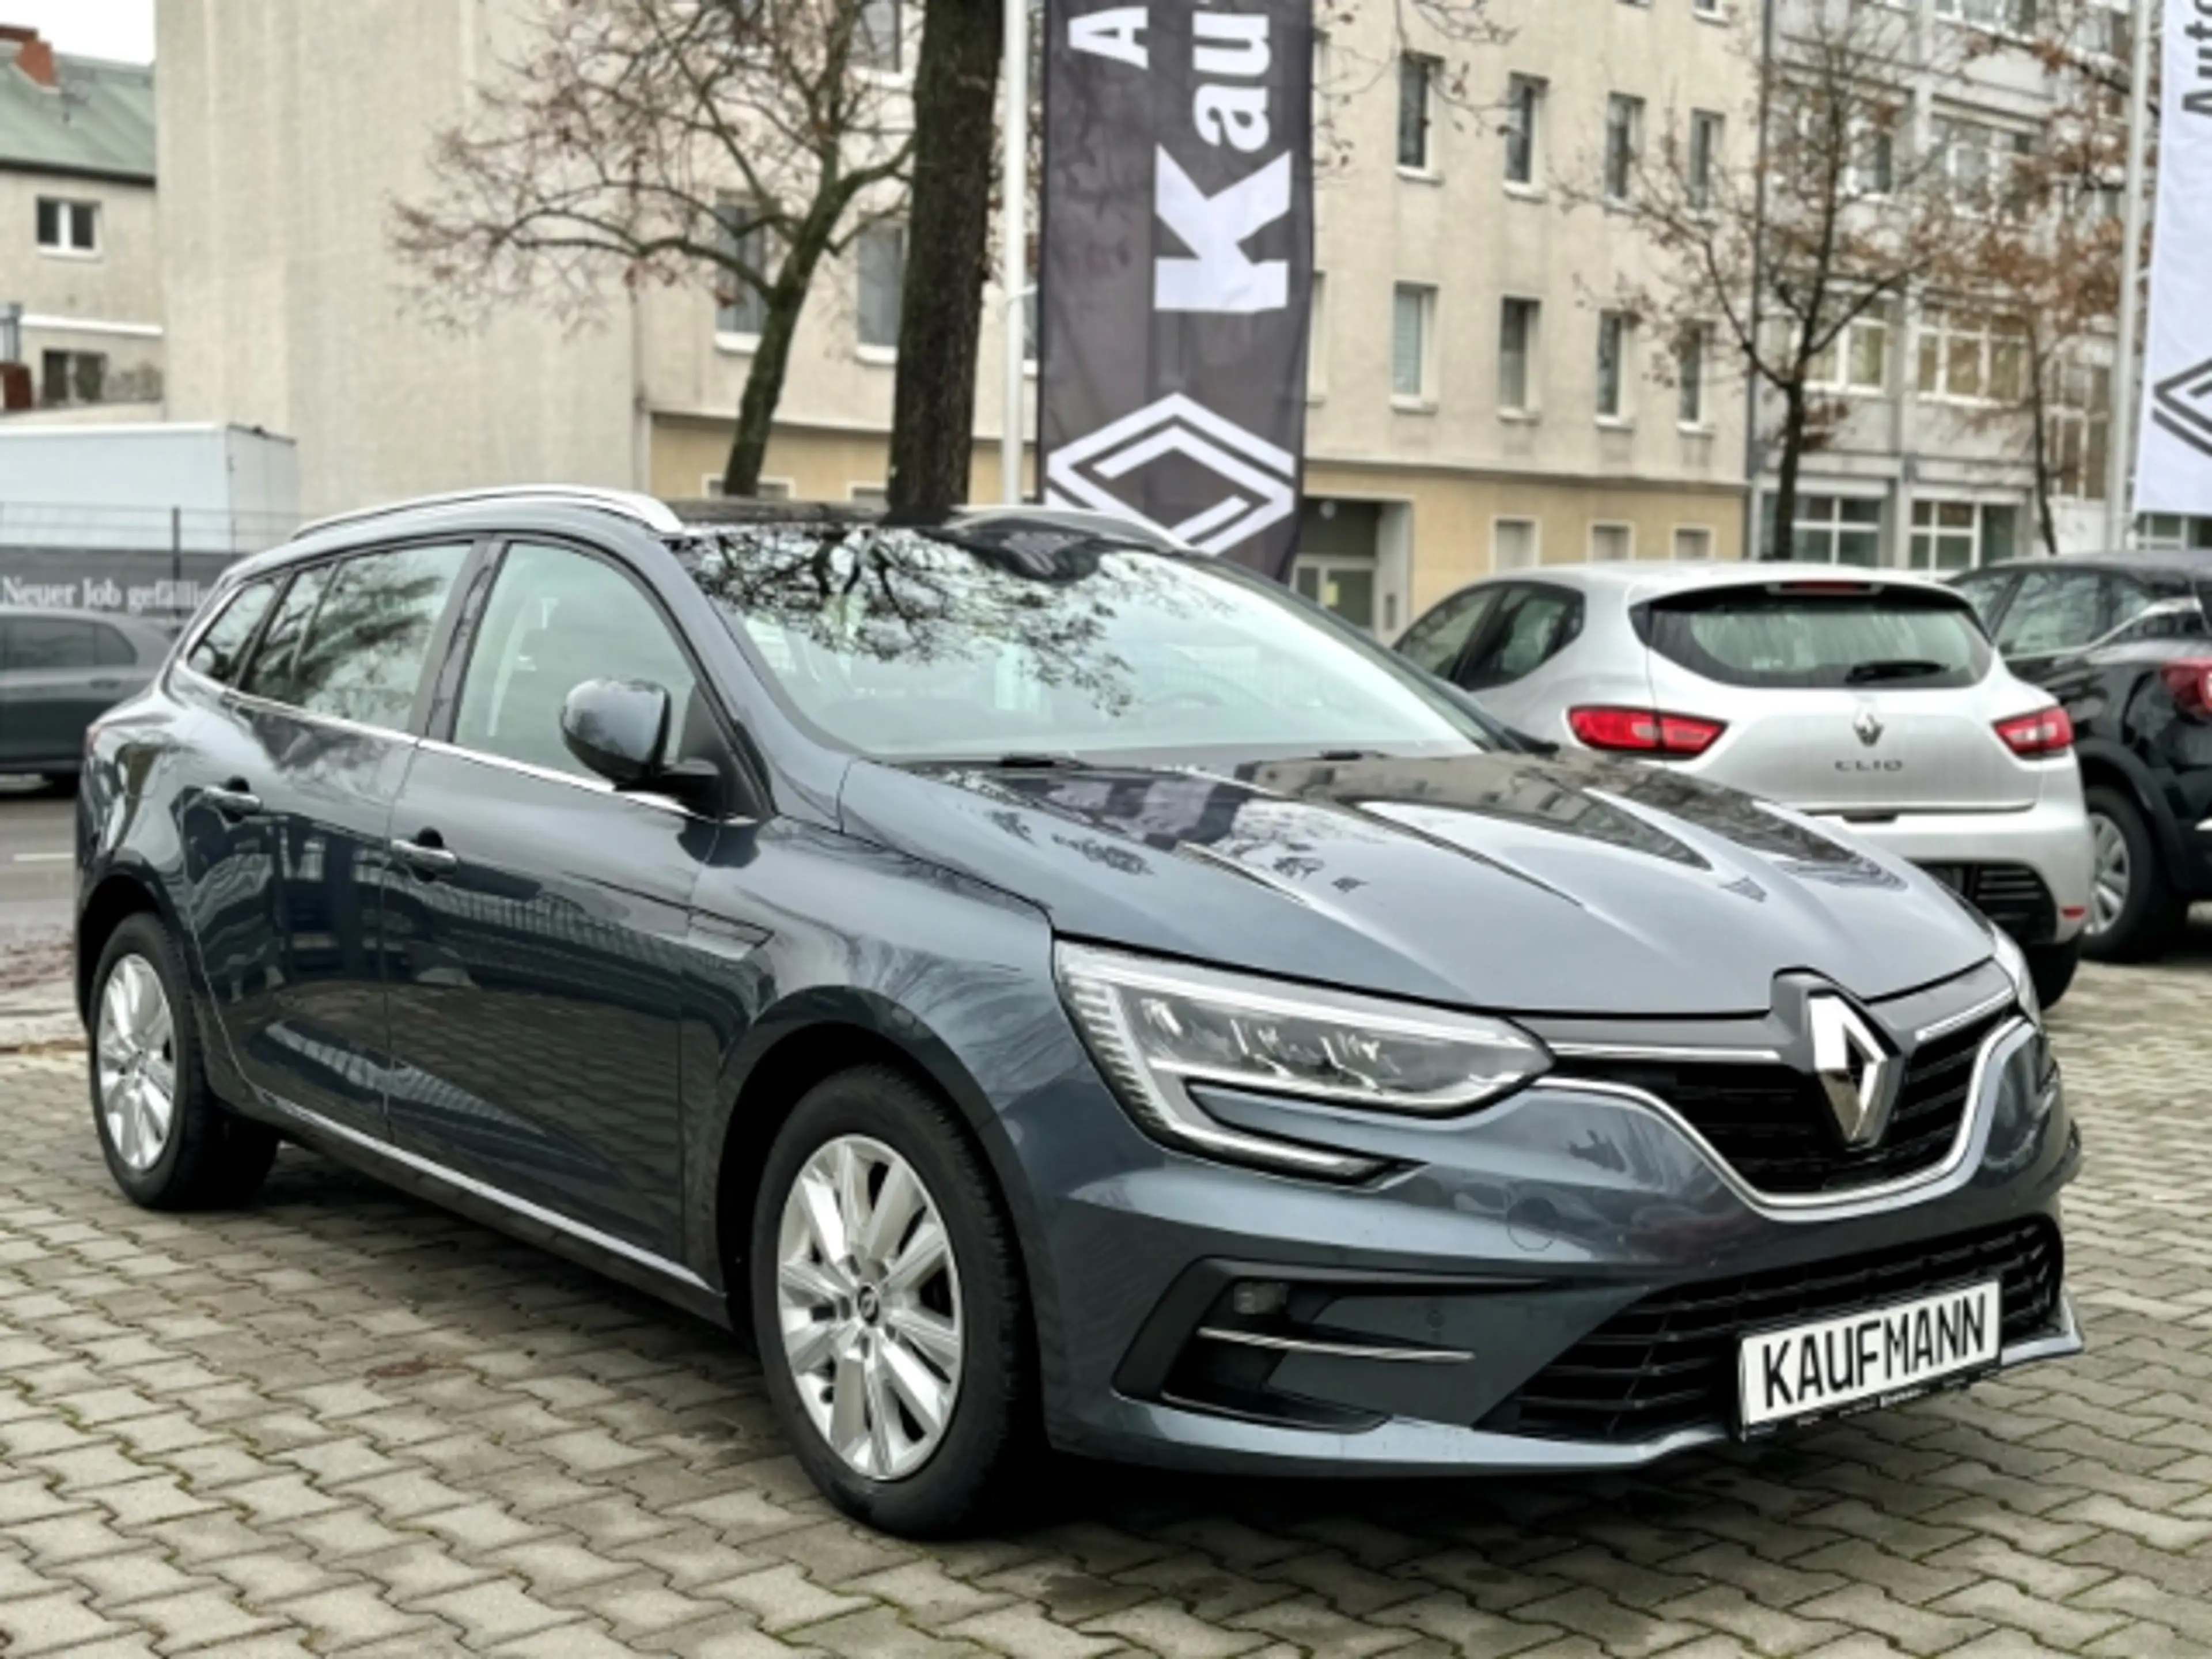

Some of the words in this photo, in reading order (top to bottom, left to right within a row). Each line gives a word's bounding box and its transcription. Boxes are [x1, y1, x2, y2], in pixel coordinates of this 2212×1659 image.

[1154, 0, 1291, 313] Kau
[2, 575, 77, 607] Neuer
[83, 576, 122, 609] Job
[1834, 759, 1903, 772] CLIO
[1763, 1292, 1986, 1410] KAUFMANN
